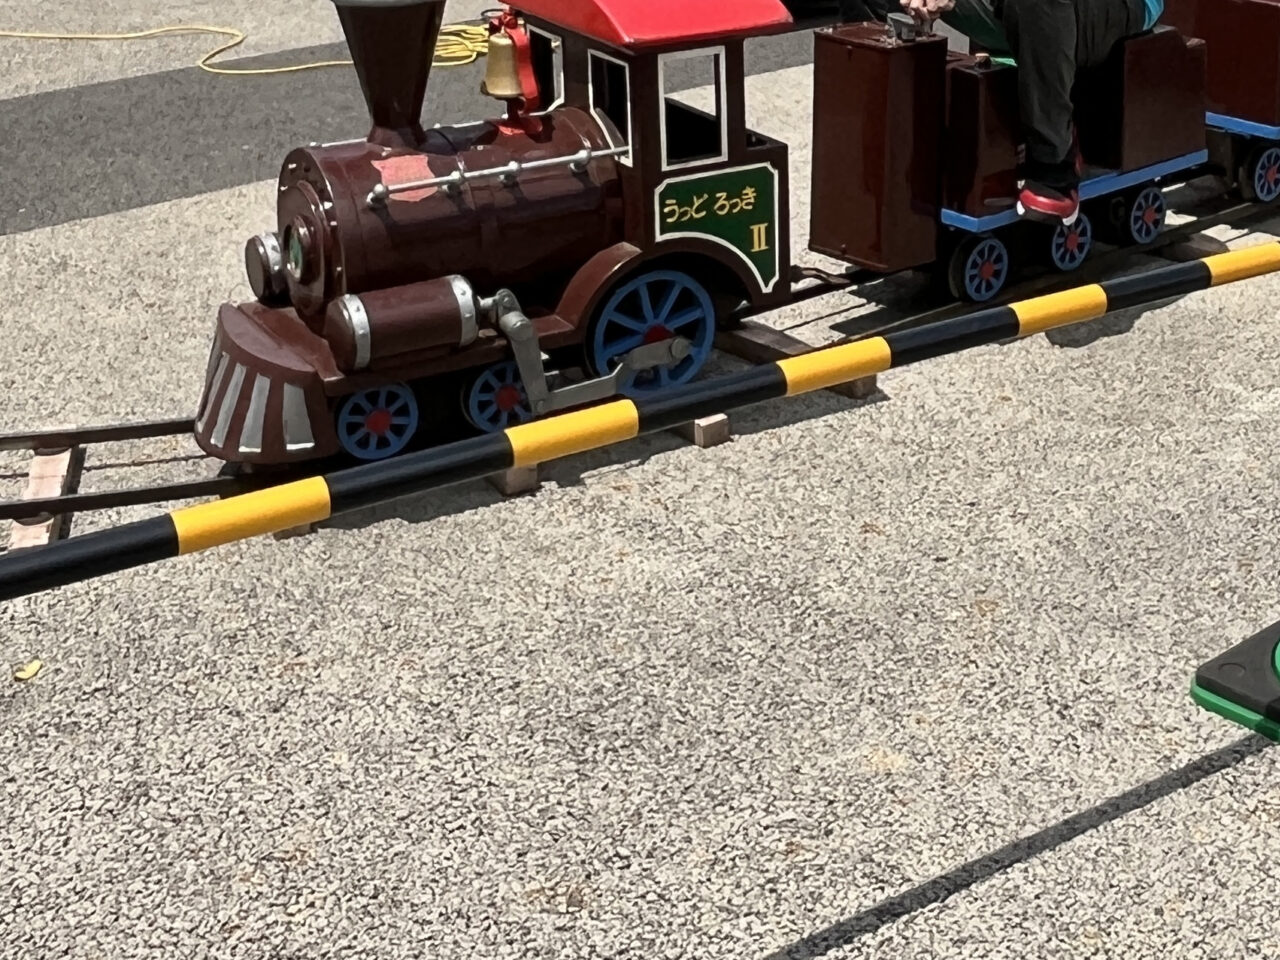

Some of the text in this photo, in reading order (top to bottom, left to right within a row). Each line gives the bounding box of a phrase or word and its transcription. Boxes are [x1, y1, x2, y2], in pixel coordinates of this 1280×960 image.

[664, 186, 757, 223] うっど ろっき
